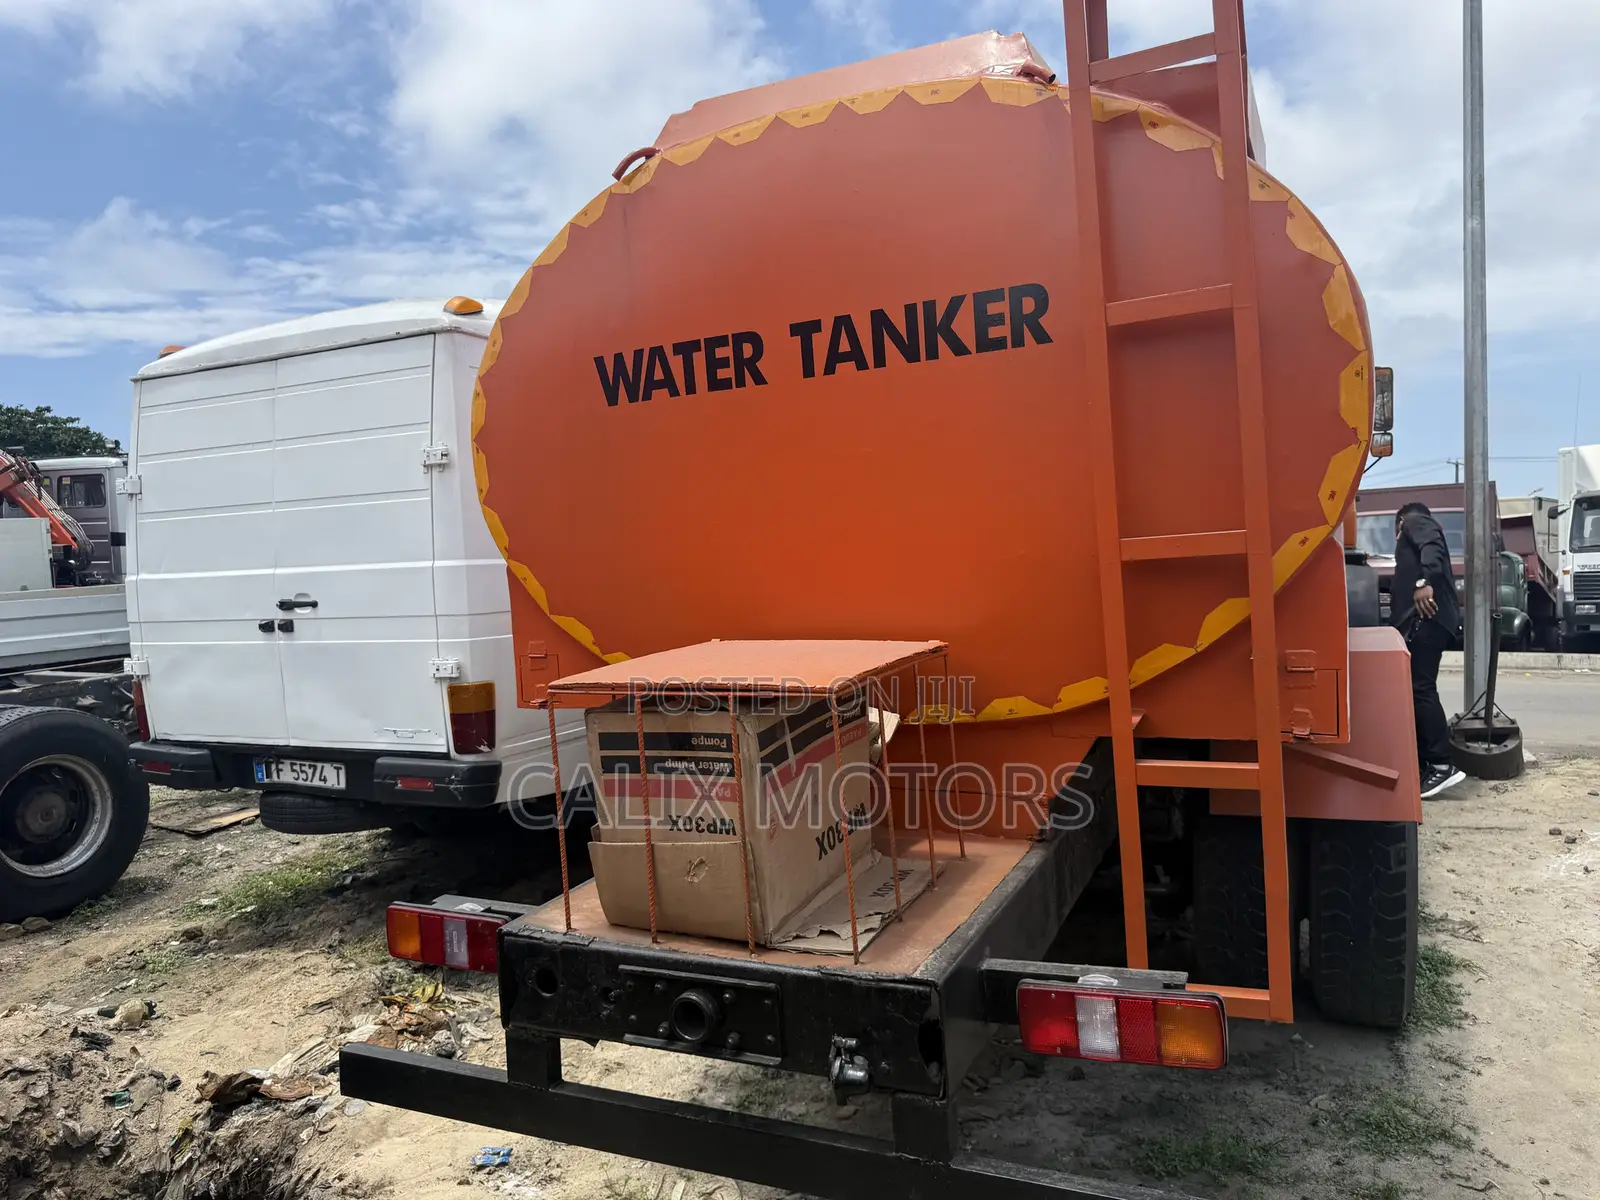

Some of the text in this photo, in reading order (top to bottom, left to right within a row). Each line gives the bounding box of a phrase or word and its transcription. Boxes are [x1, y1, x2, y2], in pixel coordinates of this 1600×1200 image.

[593, 282, 1054, 407] WATER TANKER
[691, 736, 727, 748] Pompe
[289, 762, 328, 785] 5574
[333, 765, 343, 786] T
[665, 759, 730, 773] Water Pump
[668, 814, 737, 836] WP30X
